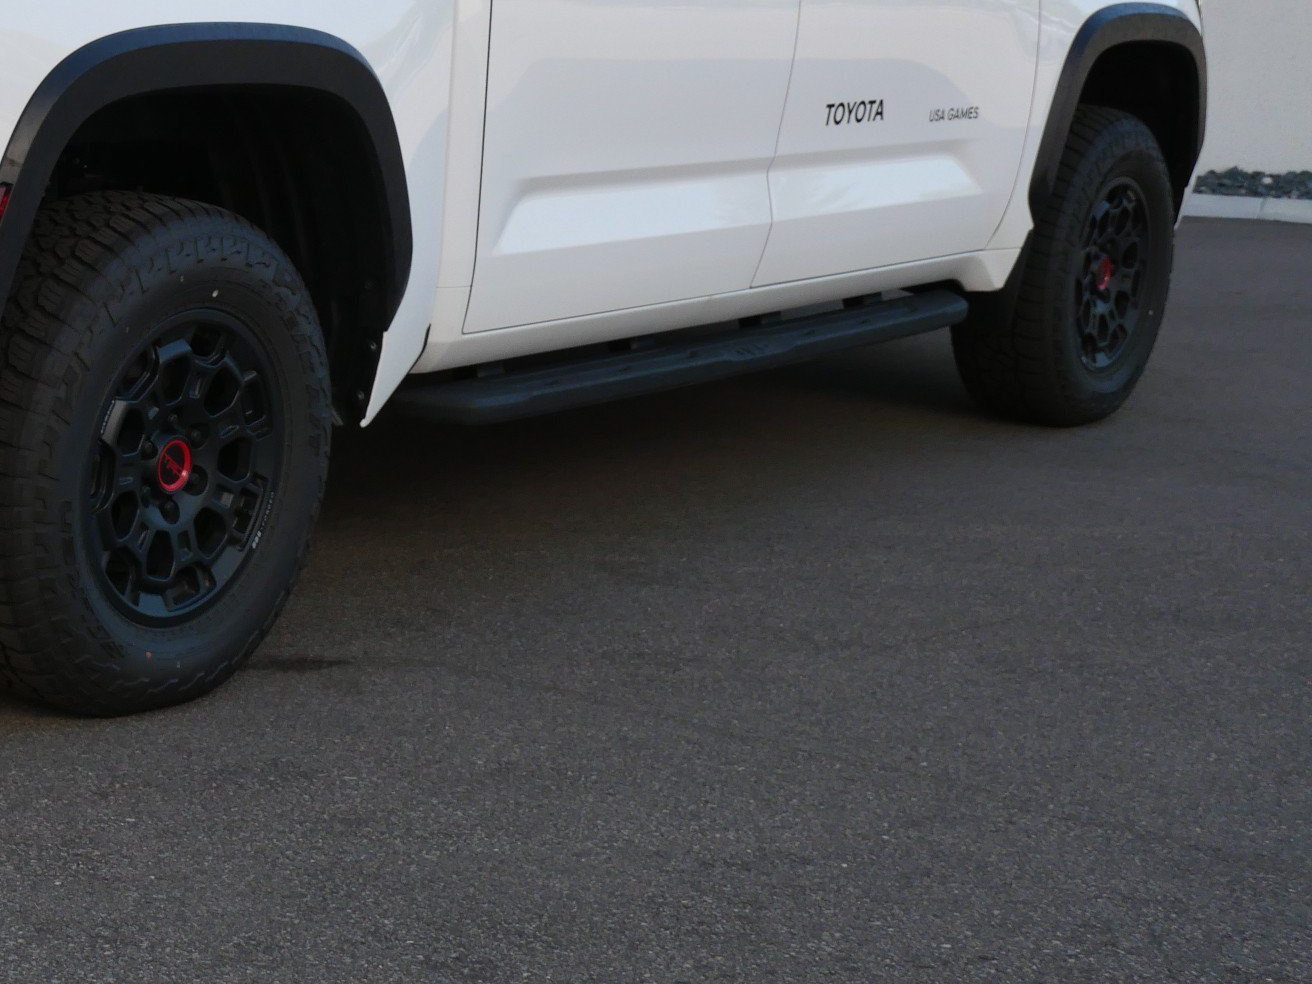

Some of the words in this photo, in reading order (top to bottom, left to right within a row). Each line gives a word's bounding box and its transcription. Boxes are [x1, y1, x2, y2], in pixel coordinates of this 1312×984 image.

[825, 99, 884, 126] TOYOTA
[929, 109, 945, 122] USA
[947, 106, 979, 121] GAMES
